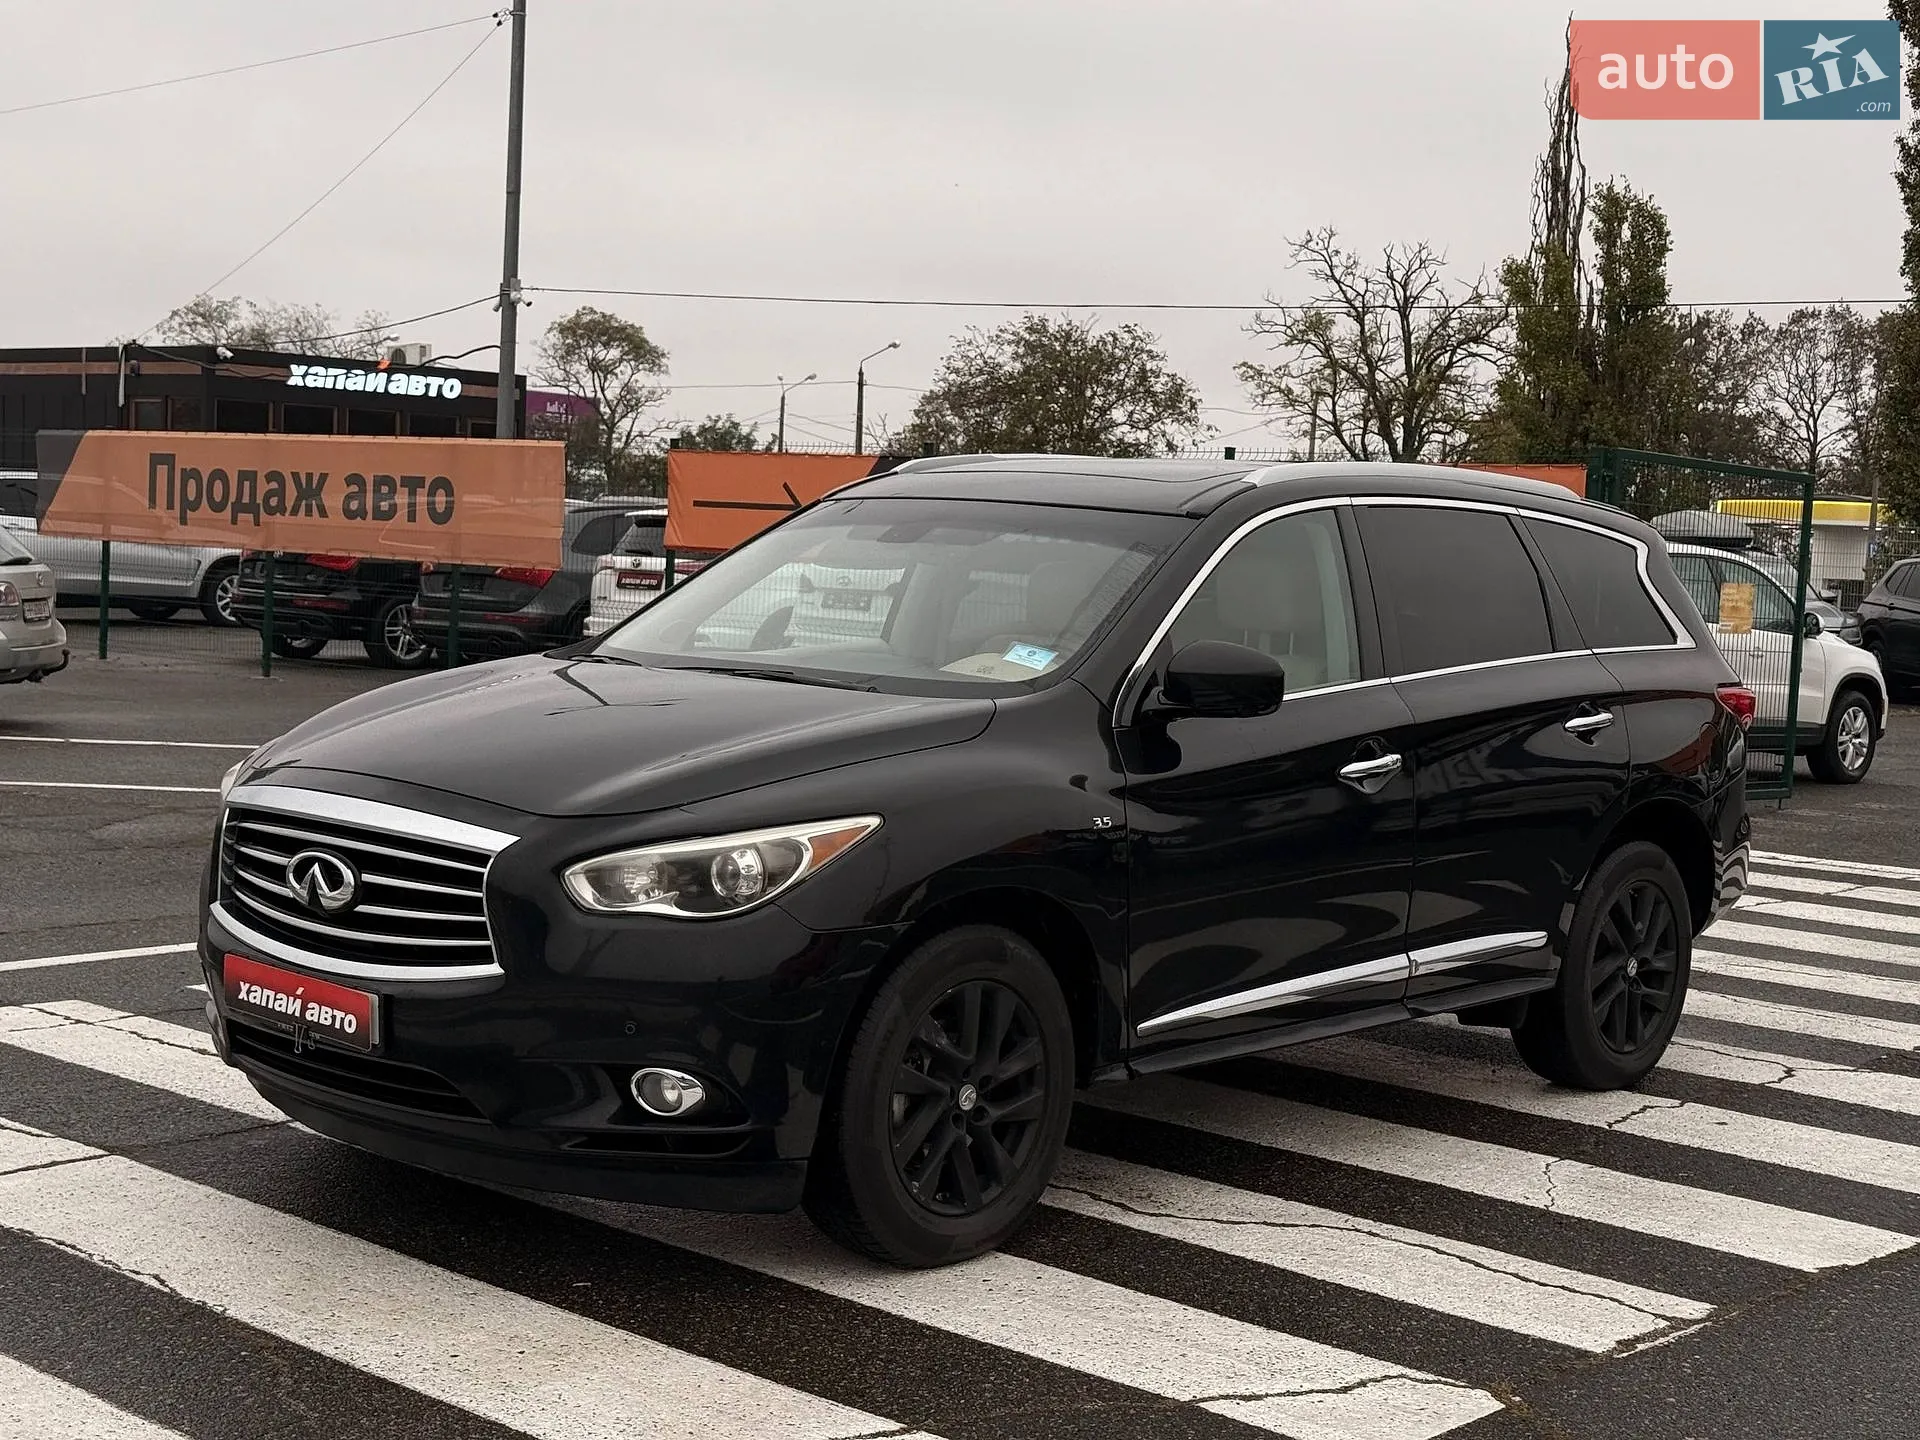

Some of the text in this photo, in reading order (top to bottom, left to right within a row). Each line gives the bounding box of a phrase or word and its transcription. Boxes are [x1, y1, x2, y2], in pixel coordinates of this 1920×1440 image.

[387, 373, 462, 399] авто
[148, 453, 455, 526] Продаж авто
[305, 1001, 357, 1034] авто
